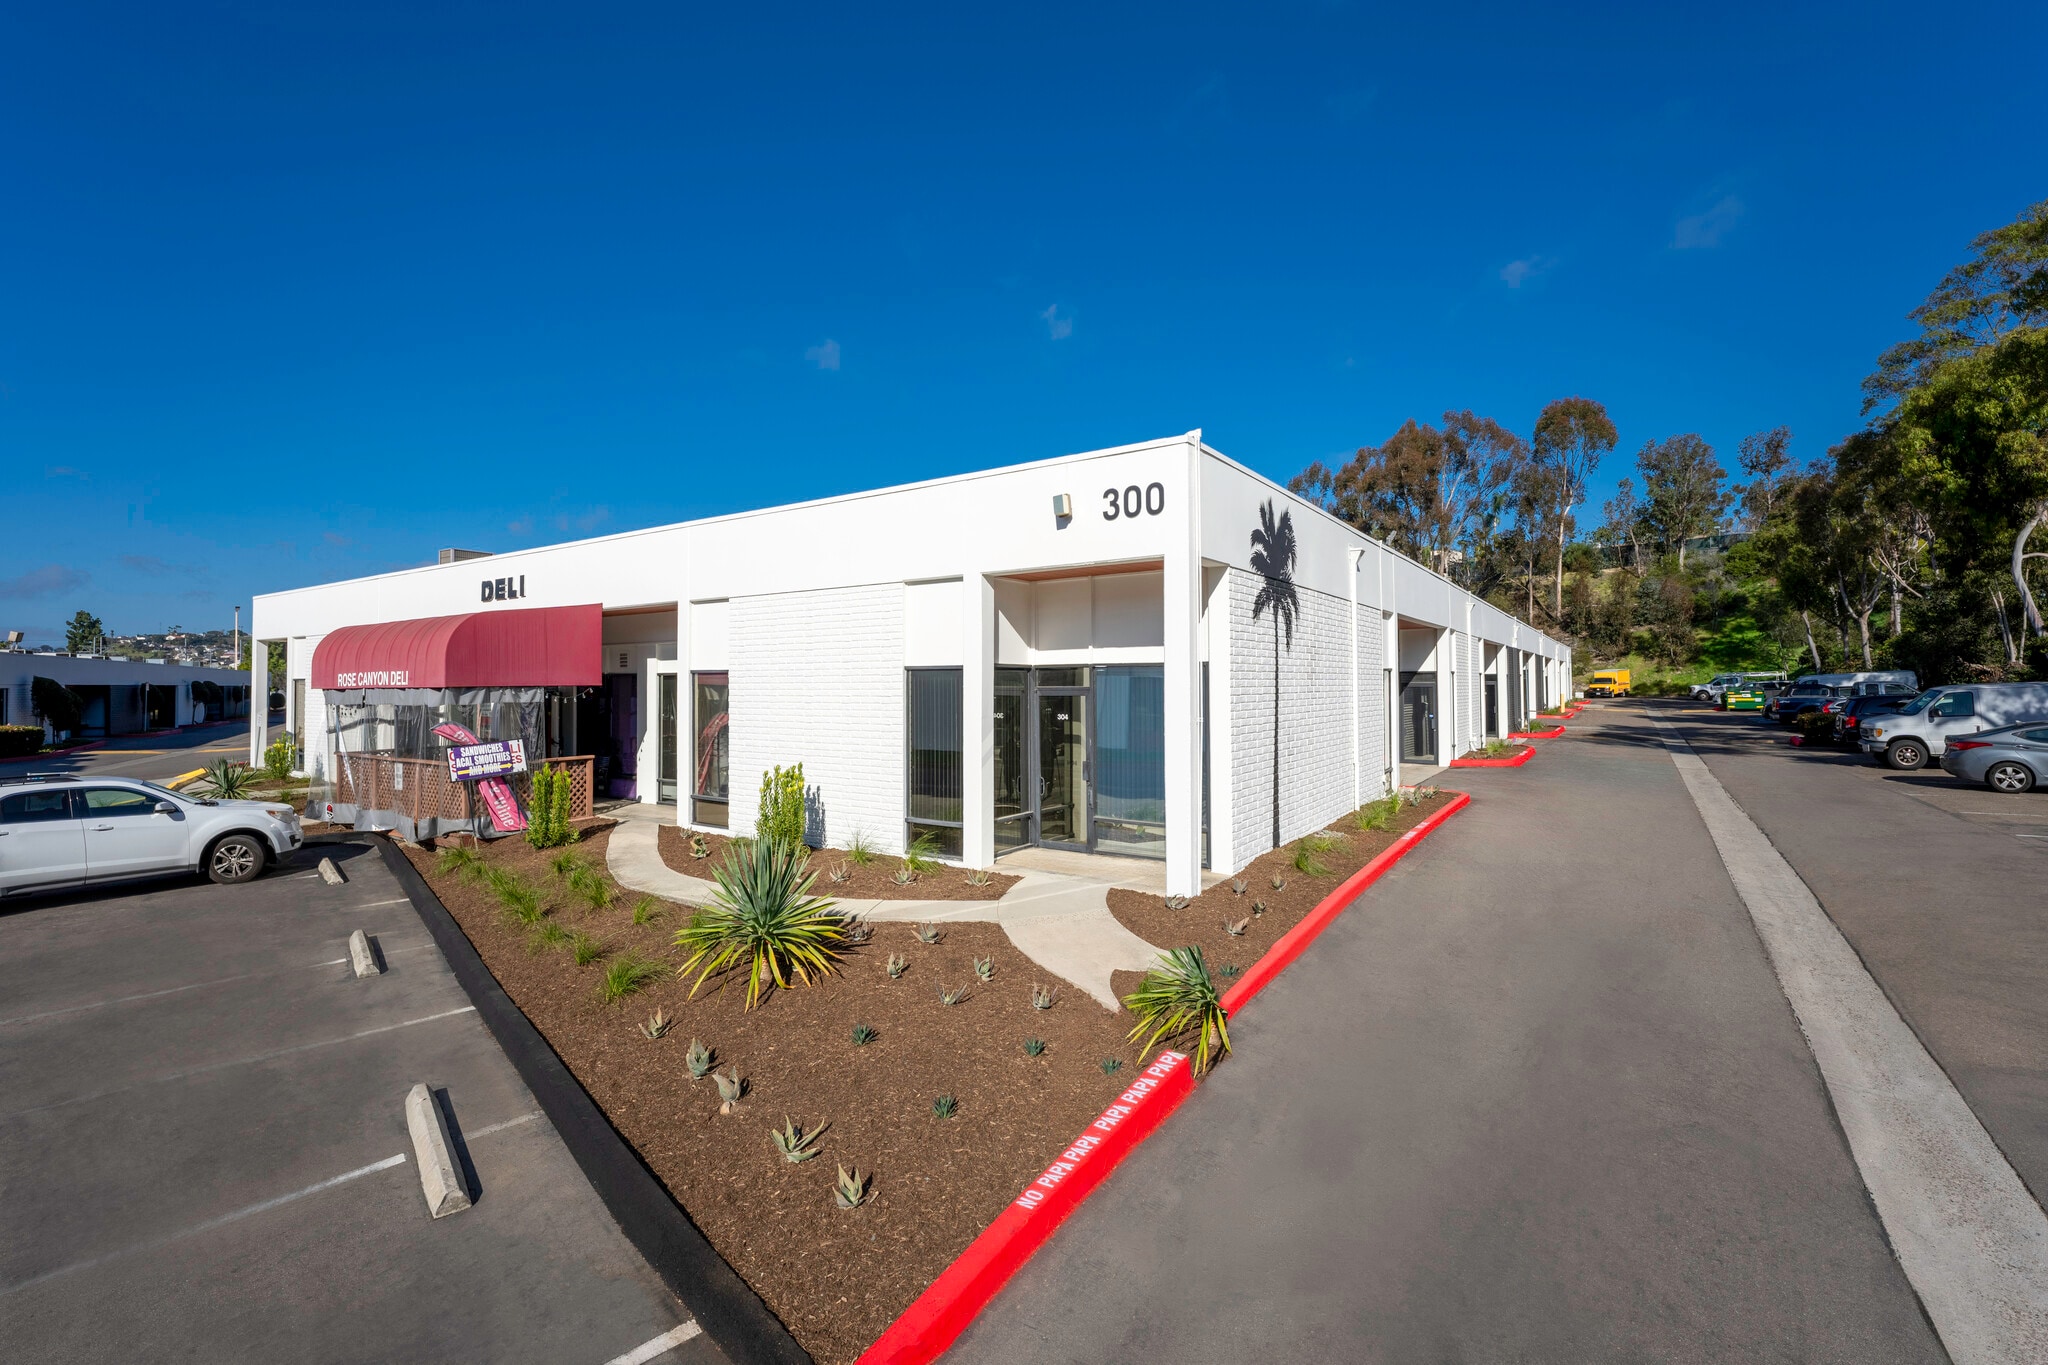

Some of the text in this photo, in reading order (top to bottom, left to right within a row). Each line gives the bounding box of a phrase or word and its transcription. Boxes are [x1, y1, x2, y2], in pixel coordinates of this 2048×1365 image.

[1102, 482, 1165, 521] 300
[481, 575, 526, 602] DELI
[337, 670, 409, 687] ROSE CANYON DELI
[460, 742, 504, 757] SANDWICHES
[474, 751, 511, 765] SMOOTHIES
[469, 765, 483, 776] AND
[483, 762, 502, 774] MORE
[494, 796, 514, 827] Wine
[1015, 1189, 1044, 1210] NO
[1036, 1162, 1074, 1188] PAPA
[1064, 1135, 1101, 1162] PAPA
[1094, 1105, 1131, 1131] PAPA
[1121, 1077, 1158, 1104] PAPA
